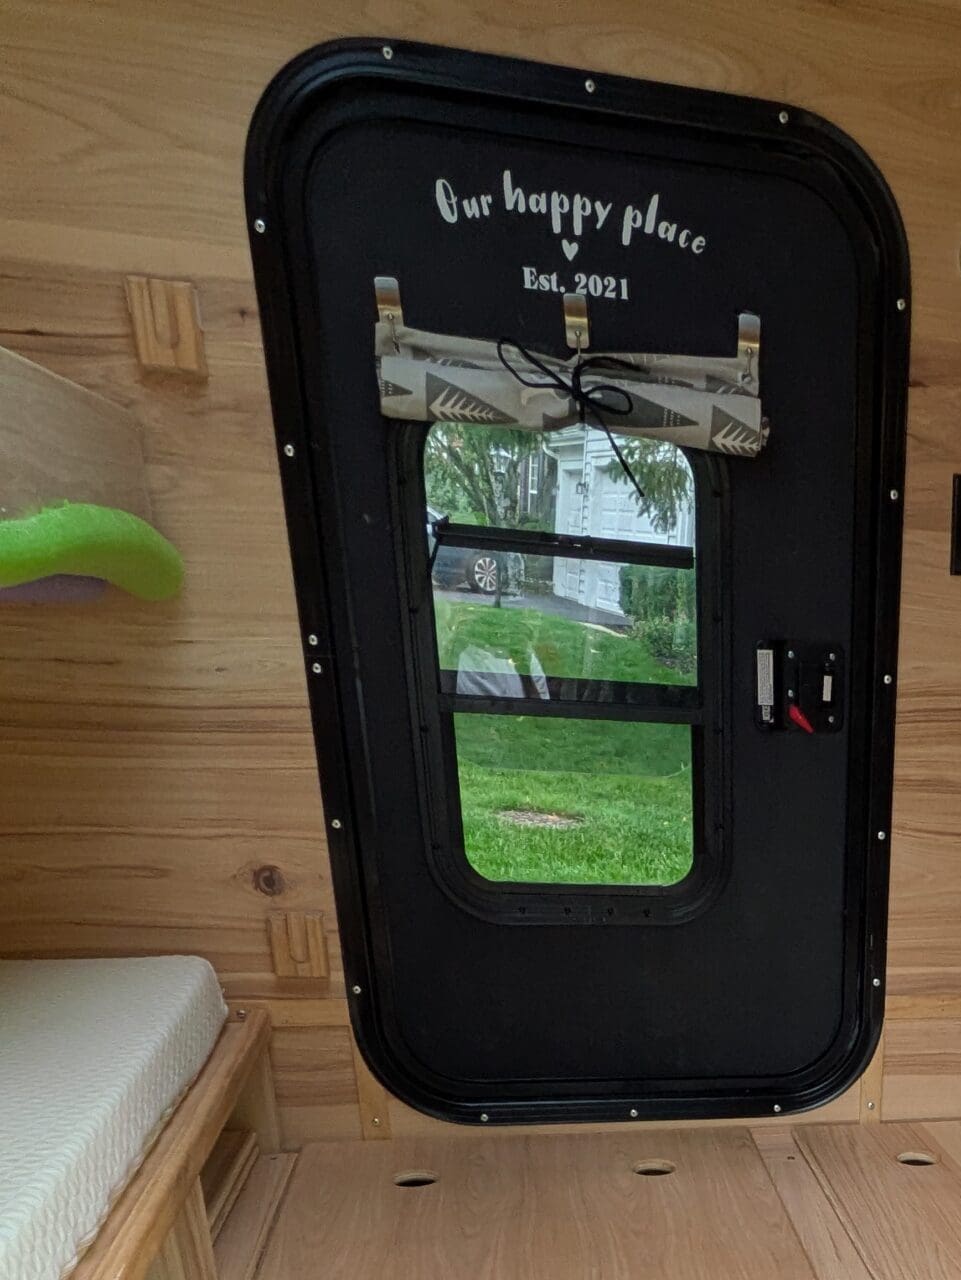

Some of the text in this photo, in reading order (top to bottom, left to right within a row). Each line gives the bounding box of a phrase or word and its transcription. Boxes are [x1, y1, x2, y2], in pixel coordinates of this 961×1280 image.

[435, 169, 706, 254] Our happy place
[522, 266, 629, 300] Est. 2021
